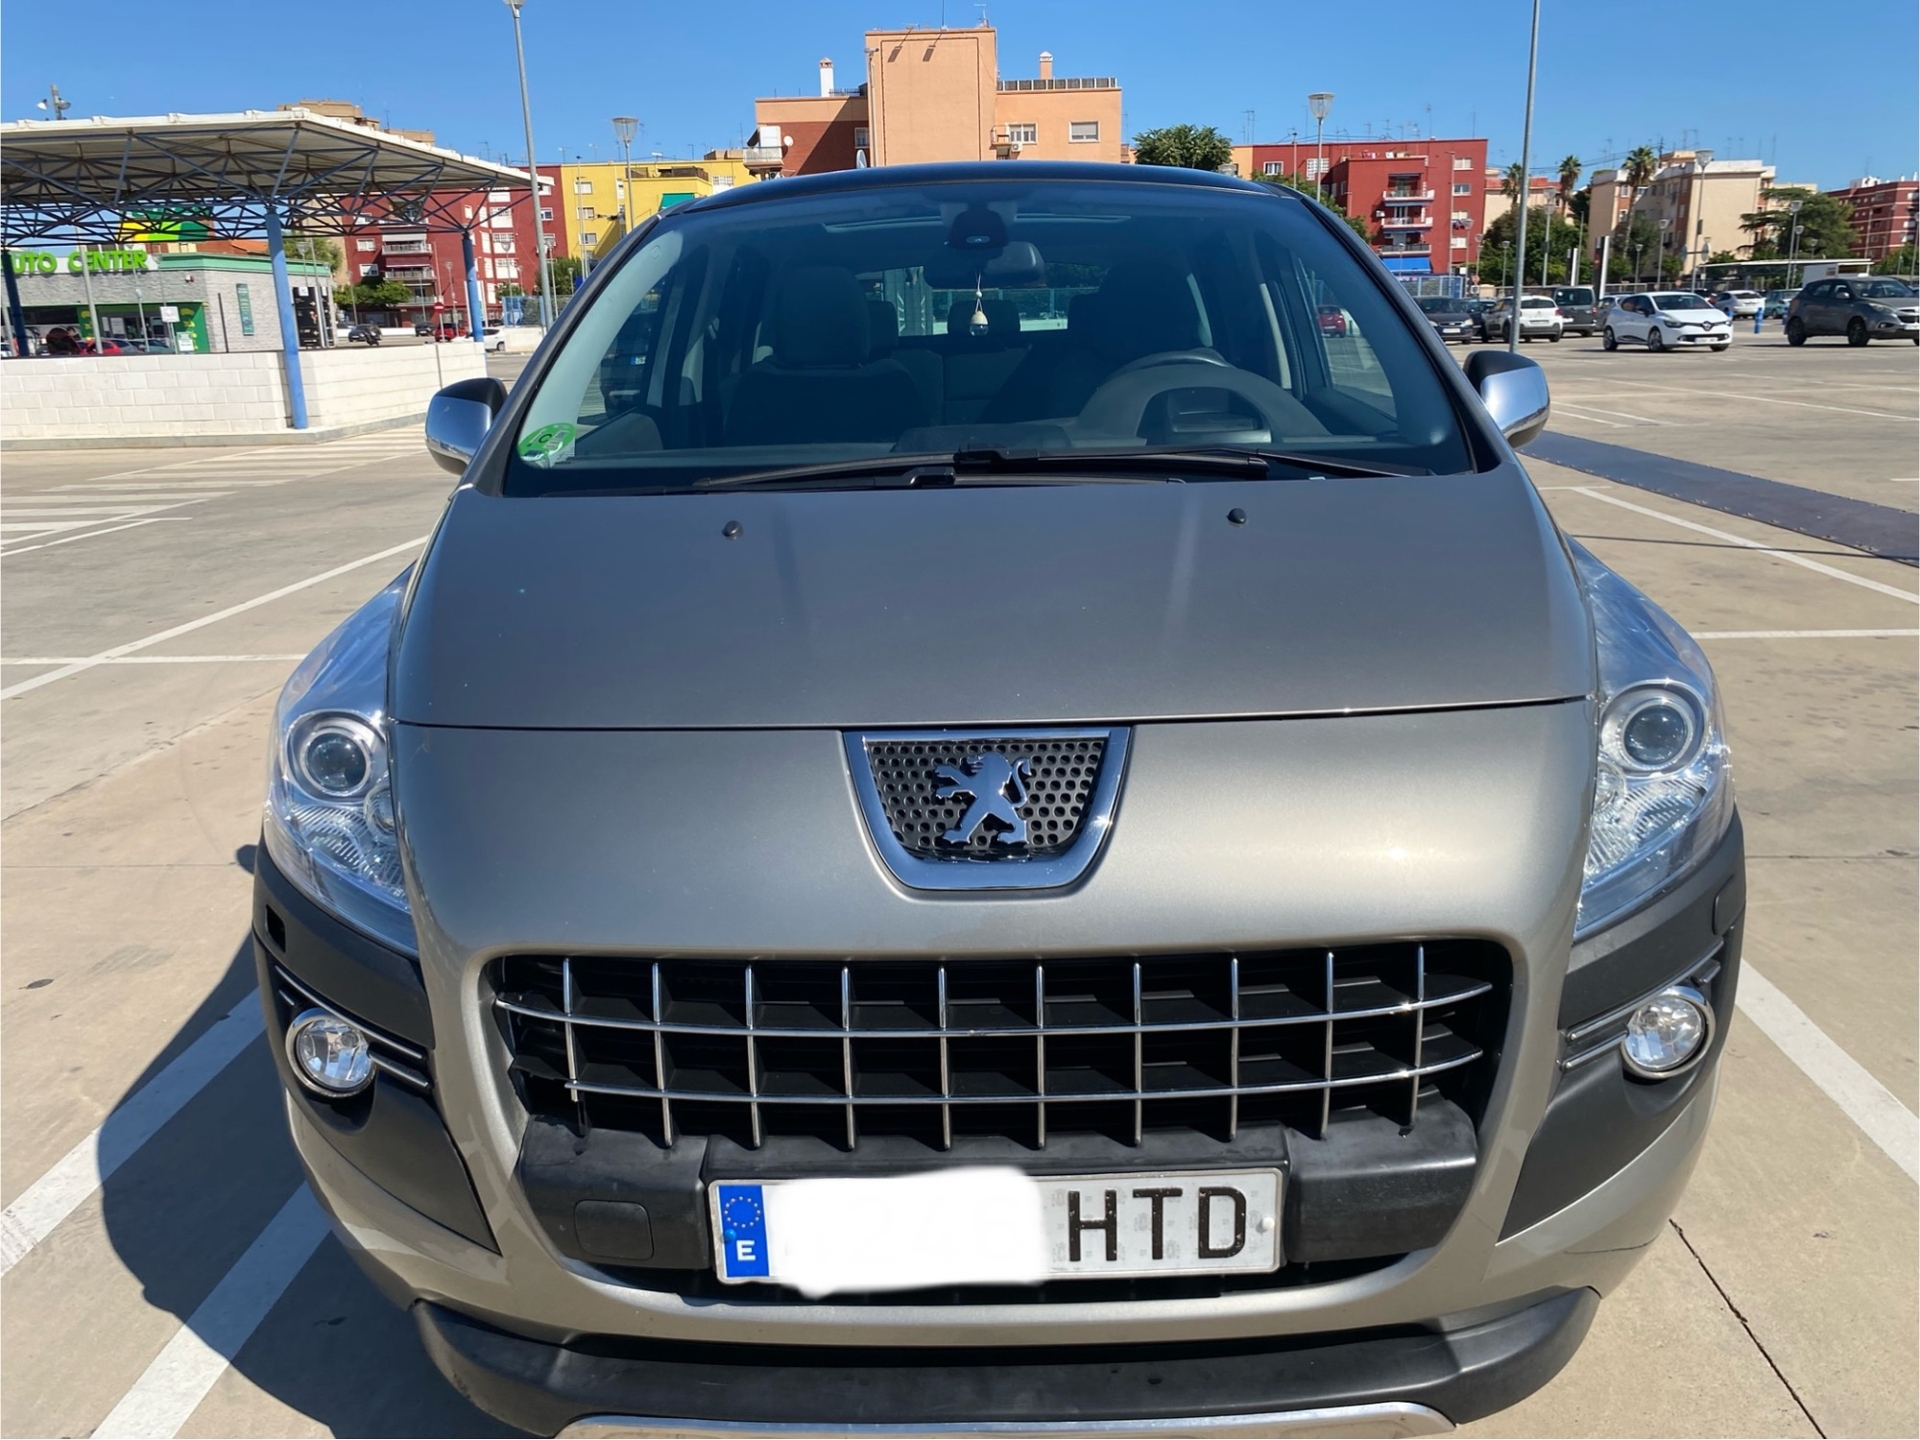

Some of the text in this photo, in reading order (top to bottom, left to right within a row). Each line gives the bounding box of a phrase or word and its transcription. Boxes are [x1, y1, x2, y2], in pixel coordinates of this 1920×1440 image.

[8, 250, 148, 273] UTO CENTER
[1067, 1186, 1247, 1262] HTD
[736, 1239, 756, 1262] E
